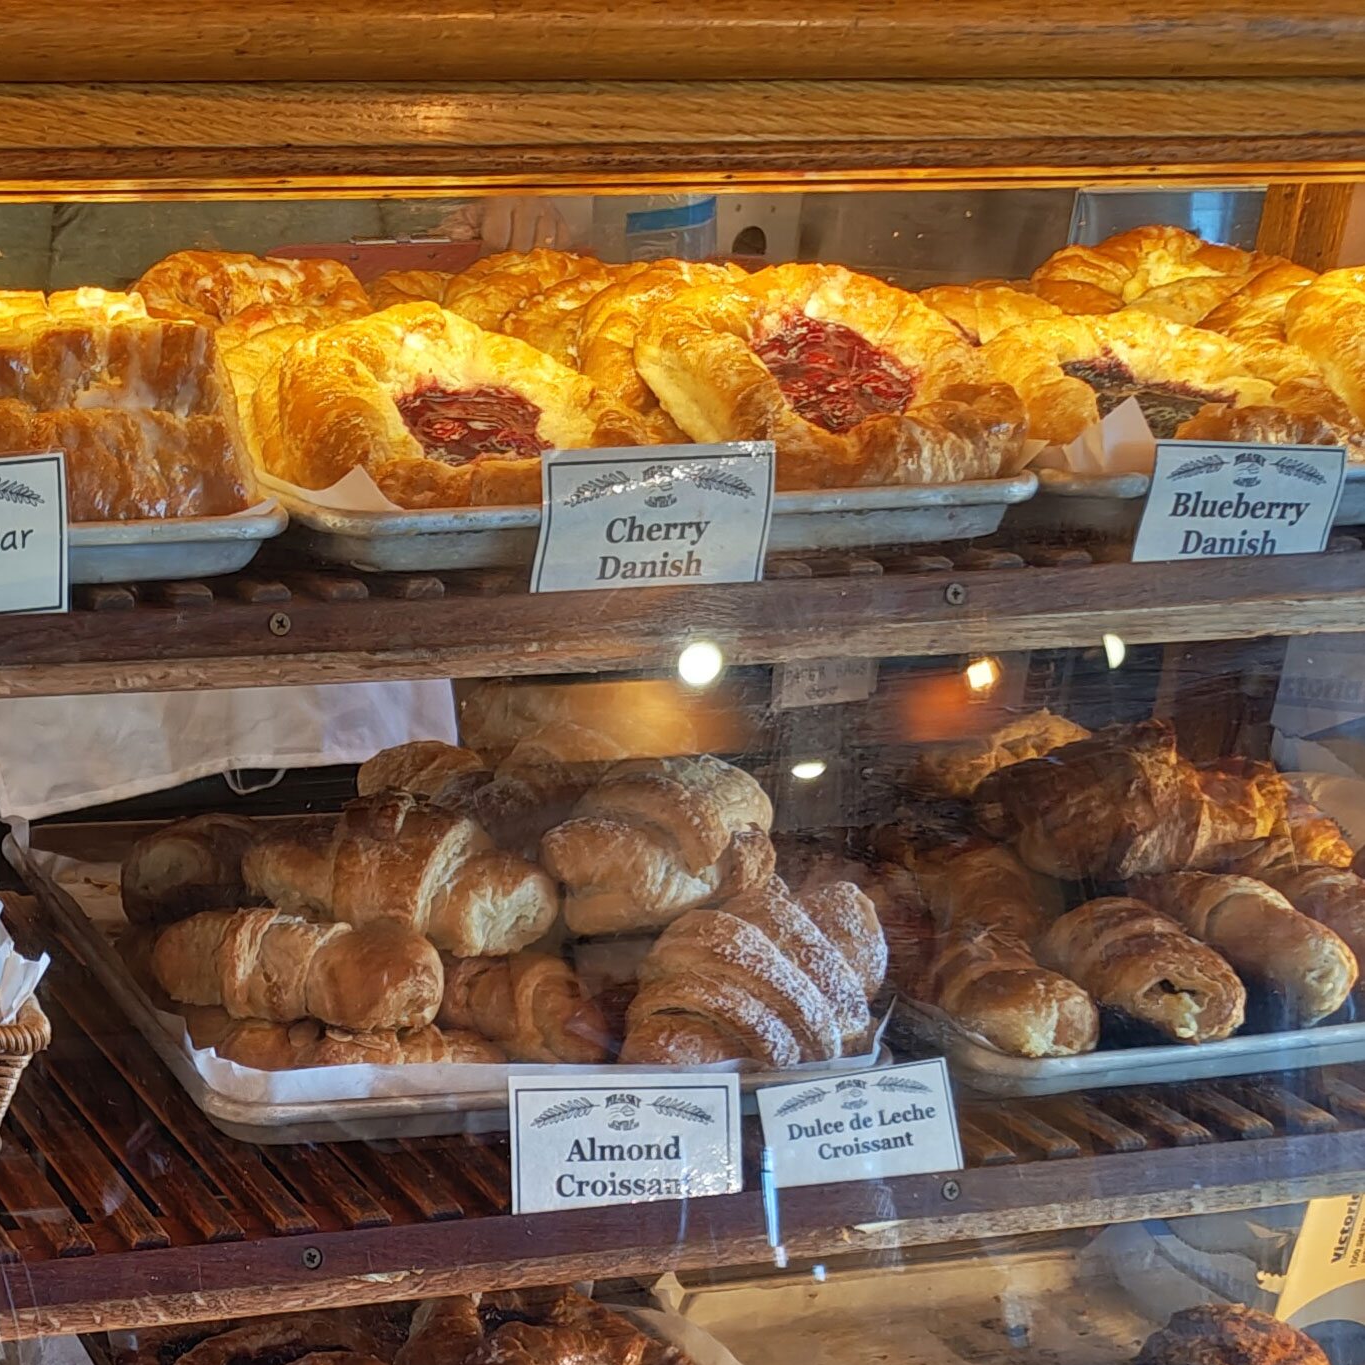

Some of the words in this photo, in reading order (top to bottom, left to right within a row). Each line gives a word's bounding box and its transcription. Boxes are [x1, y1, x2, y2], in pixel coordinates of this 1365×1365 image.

[1169, 491, 1311, 526] Blueberry
[606, 516, 710, 545] Cherry
[1179, 530, 1277, 556] Danish
[596, 551, 702, 581] Danish
[788, 1118, 844, 1141] Dulce
[849, 1113, 873, 1131] de
[878, 1103, 936, 1126] Leche
[565, 1136, 681, 1162] Almond
[818, 1131, 914, 1160] Croissant
[556, 1172, 691, 1197] Croissan
